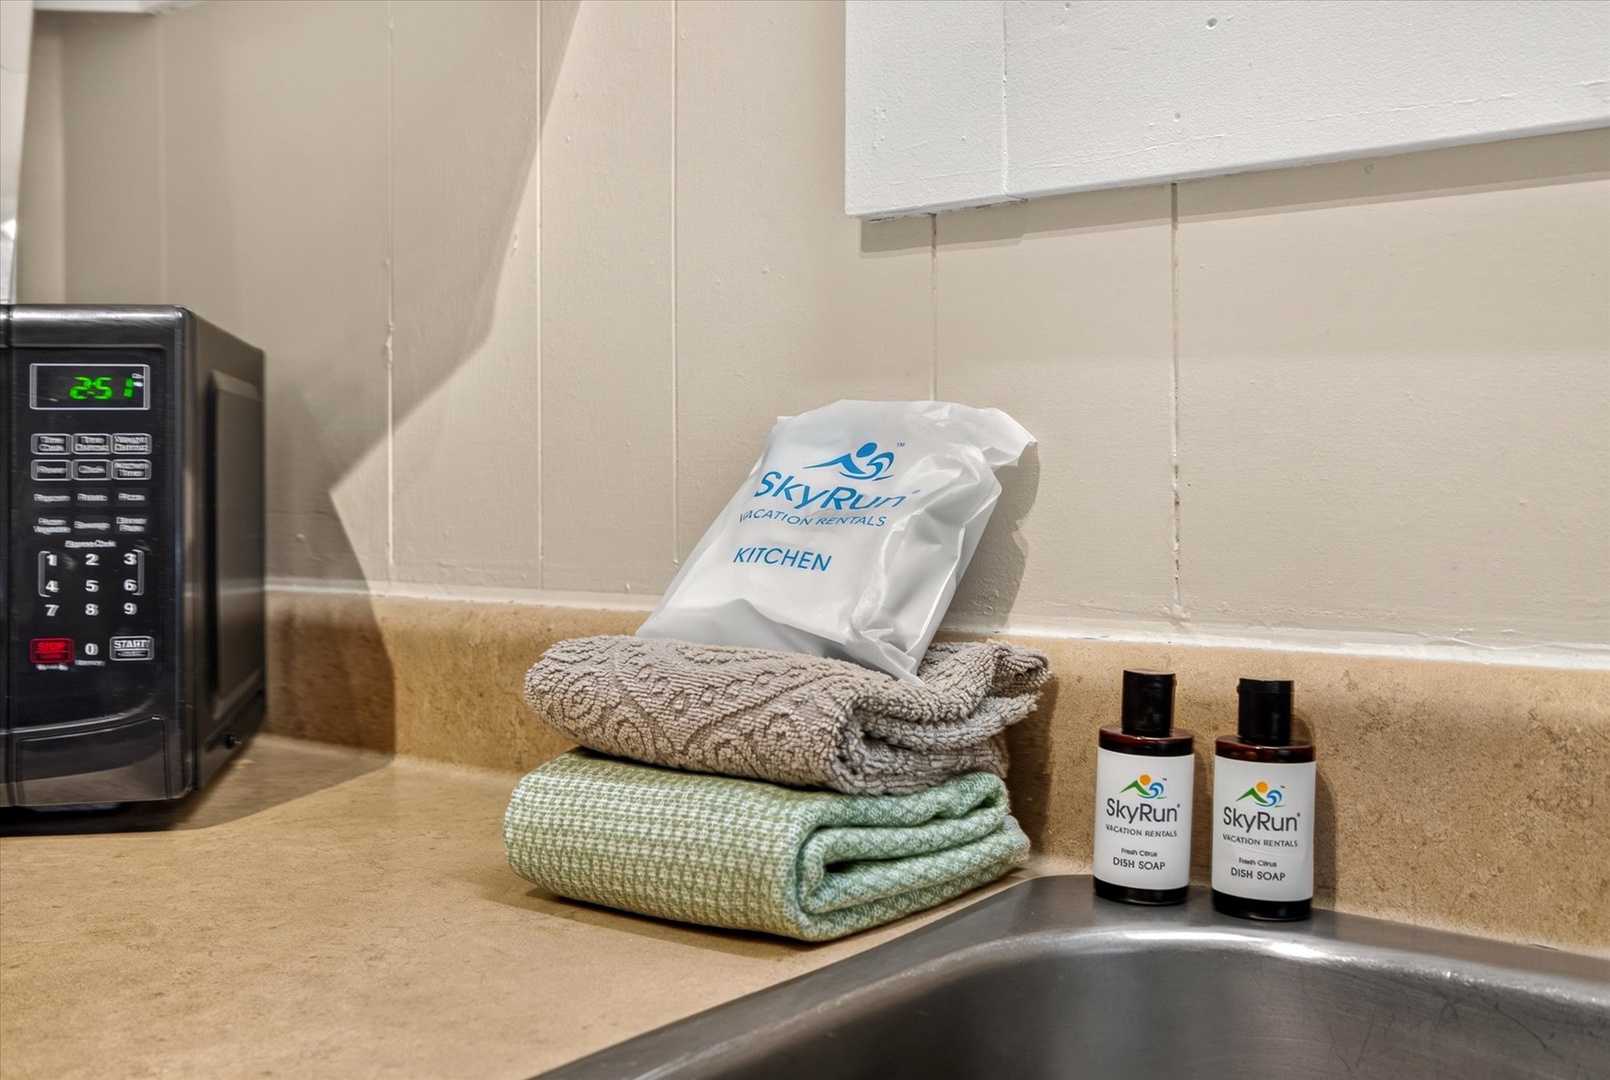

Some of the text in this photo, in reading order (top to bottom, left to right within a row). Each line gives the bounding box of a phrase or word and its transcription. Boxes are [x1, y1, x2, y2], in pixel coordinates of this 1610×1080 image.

[754, 471, 907, 510] SkyRun
[739, 508, 887, 527] VACATION RENTALS
[46, 554, 58, 566] 1
[85, 553, 99, 566] 2
[123, 552, 137, 565] 3
[733, 547, 832, 571] KITCHEN
[45, 580, 60, 593] 4
[85, 580, 99, 592] 5
[123, 579, 137, 592] 6
[45, 604, 60, 617] 7
[85, 603, 99, 616] 8
[123, 602, 137, 615] 9
[84, 643, 98, 656] 0
[114, 640, 150, 649] START
[1106, 798, 1178, 824] SkyRun
[1223, 806, 1298, 833] SkyRun
[1105, 824, 1142, 836] VACATION
[1222, 833, 1260, 845] VACATION
[1113, 857, 1166, 870] DISH SOAP
[1230, 867, 1286, 881] DISH SOAP
